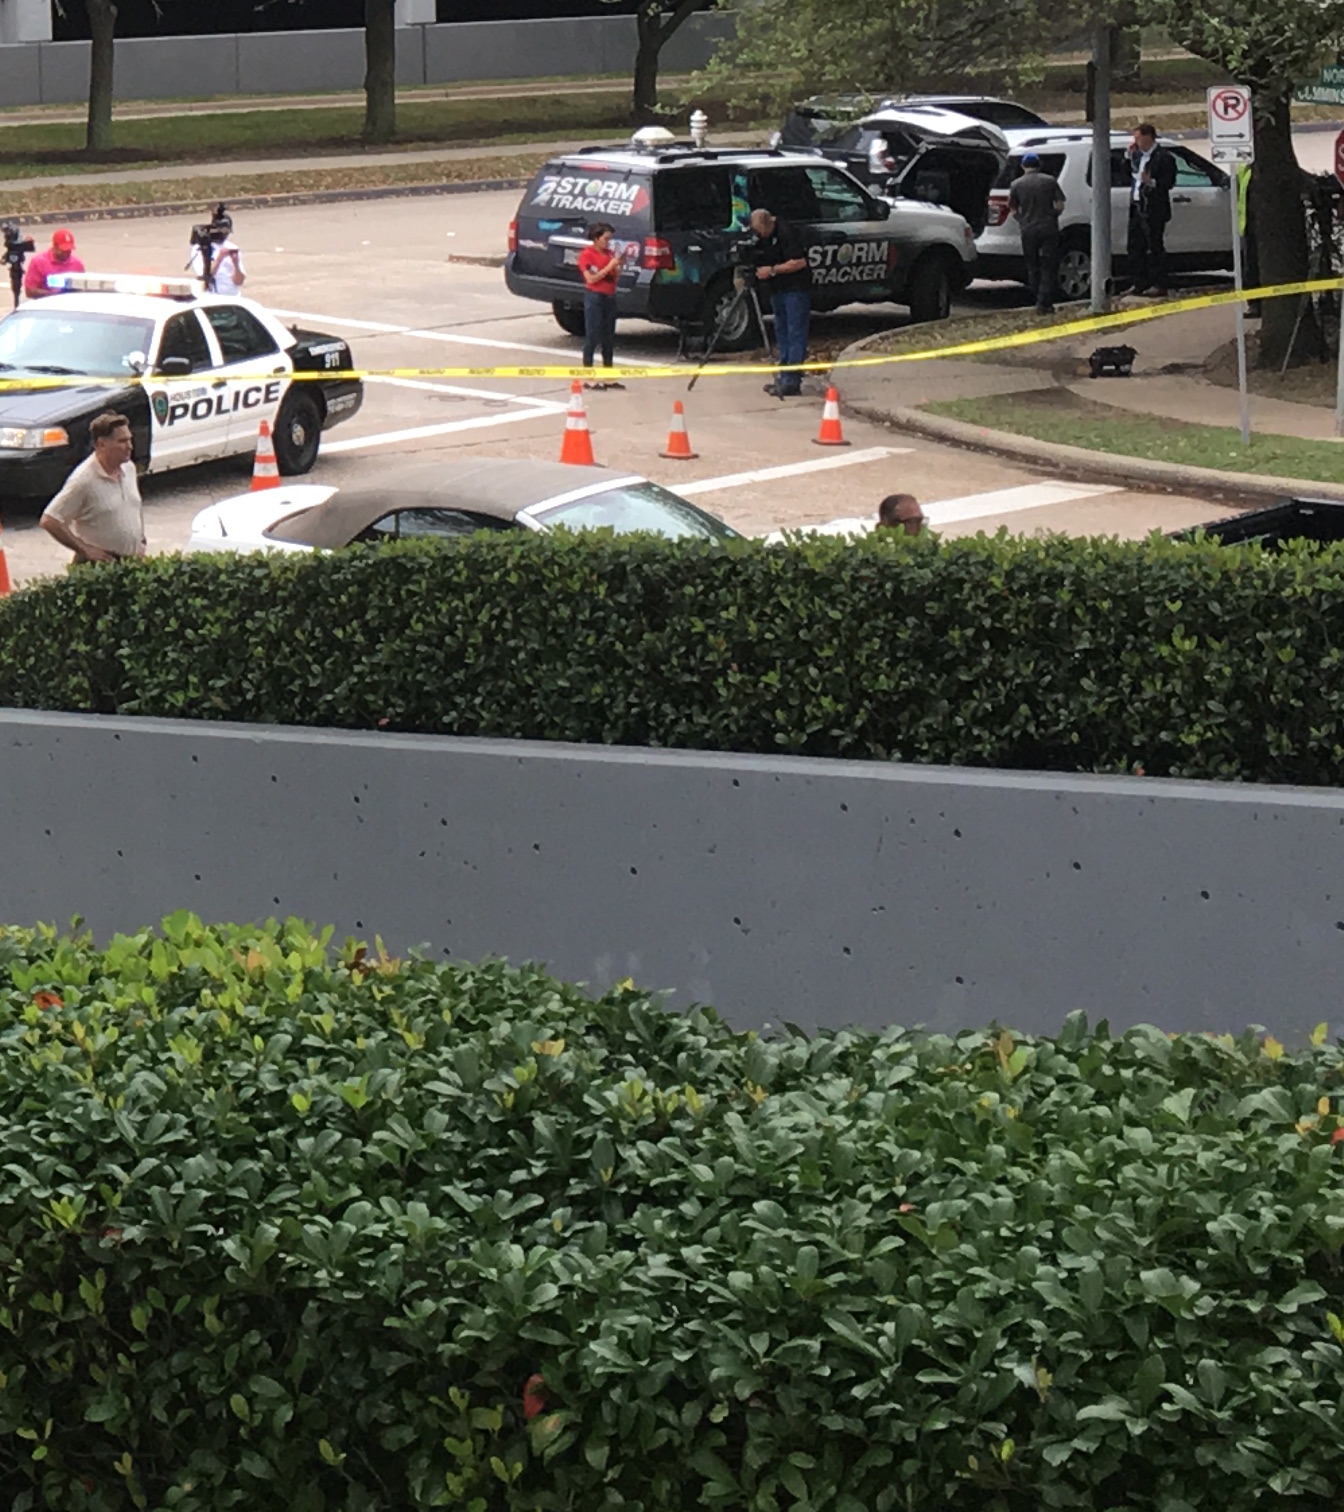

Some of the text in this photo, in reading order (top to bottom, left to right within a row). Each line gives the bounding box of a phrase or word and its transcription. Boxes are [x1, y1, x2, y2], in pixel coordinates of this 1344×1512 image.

[557, 177, 640, 201] STORM
[550, 194, 634, 216] TRACKER
[808, 241, 889, 267] STORM
[812, 264, 887, 285] RACKER
[324, 352, 340, 368] 911
[168, 382, 281, 426] POLICE
[170, 387, 207, 402] HOUSTON
